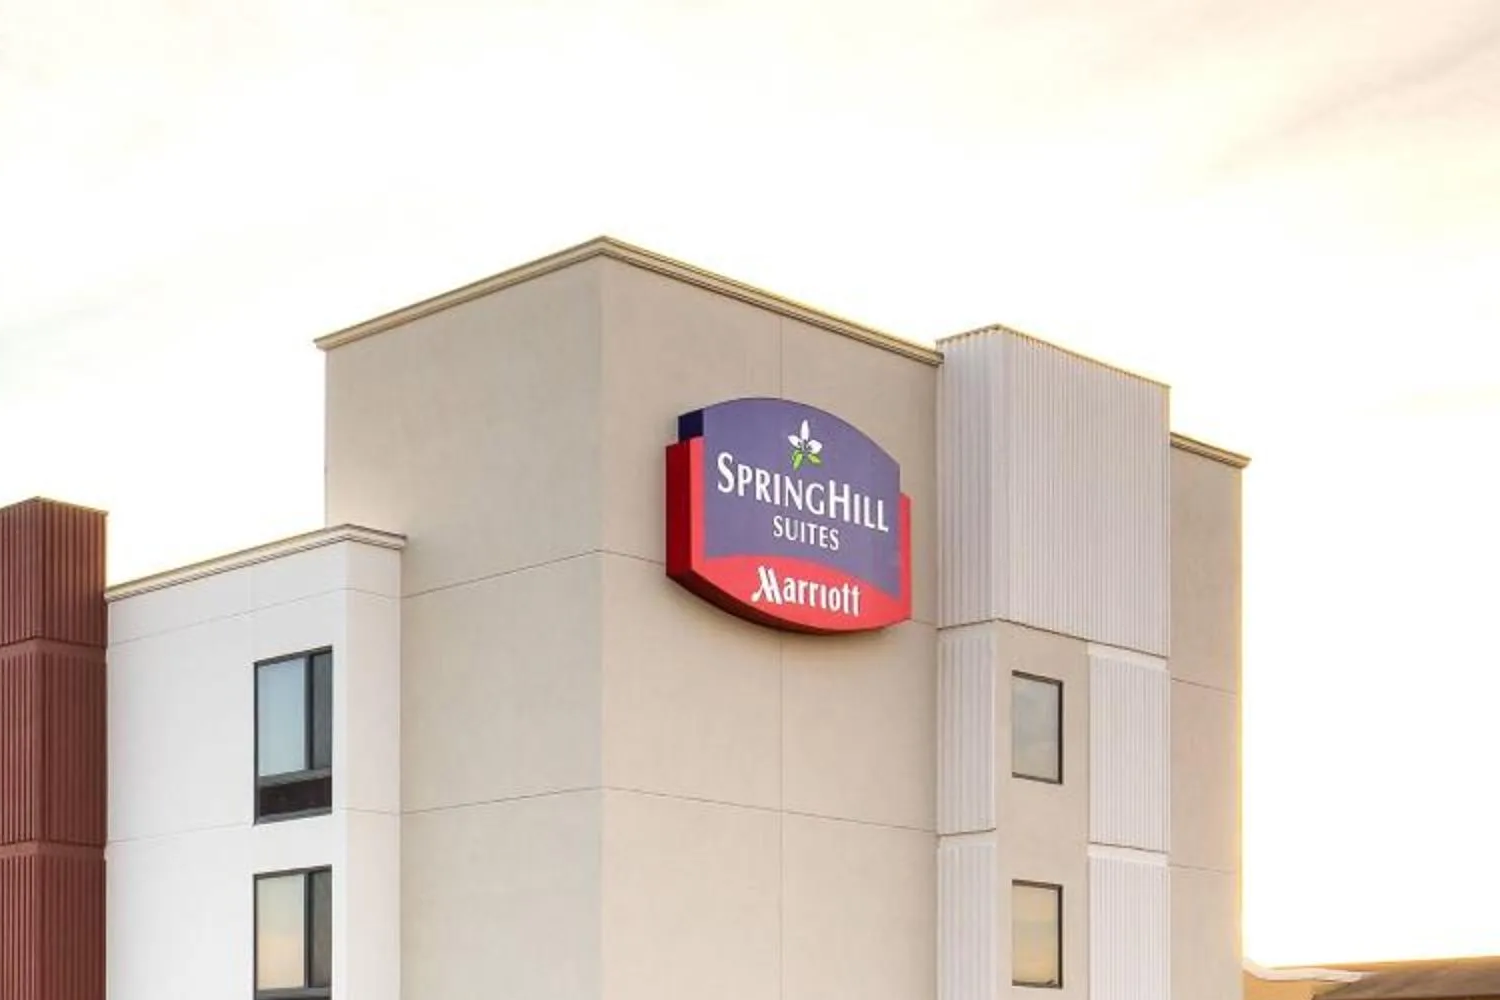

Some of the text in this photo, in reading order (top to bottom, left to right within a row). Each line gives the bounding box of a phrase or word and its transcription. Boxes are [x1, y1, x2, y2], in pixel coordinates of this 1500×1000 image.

[717, 451, 889, 532] SPRINGHILL
[773, 515, 840, 550] SUITES
[751, 565, 861, 617] Marriott
